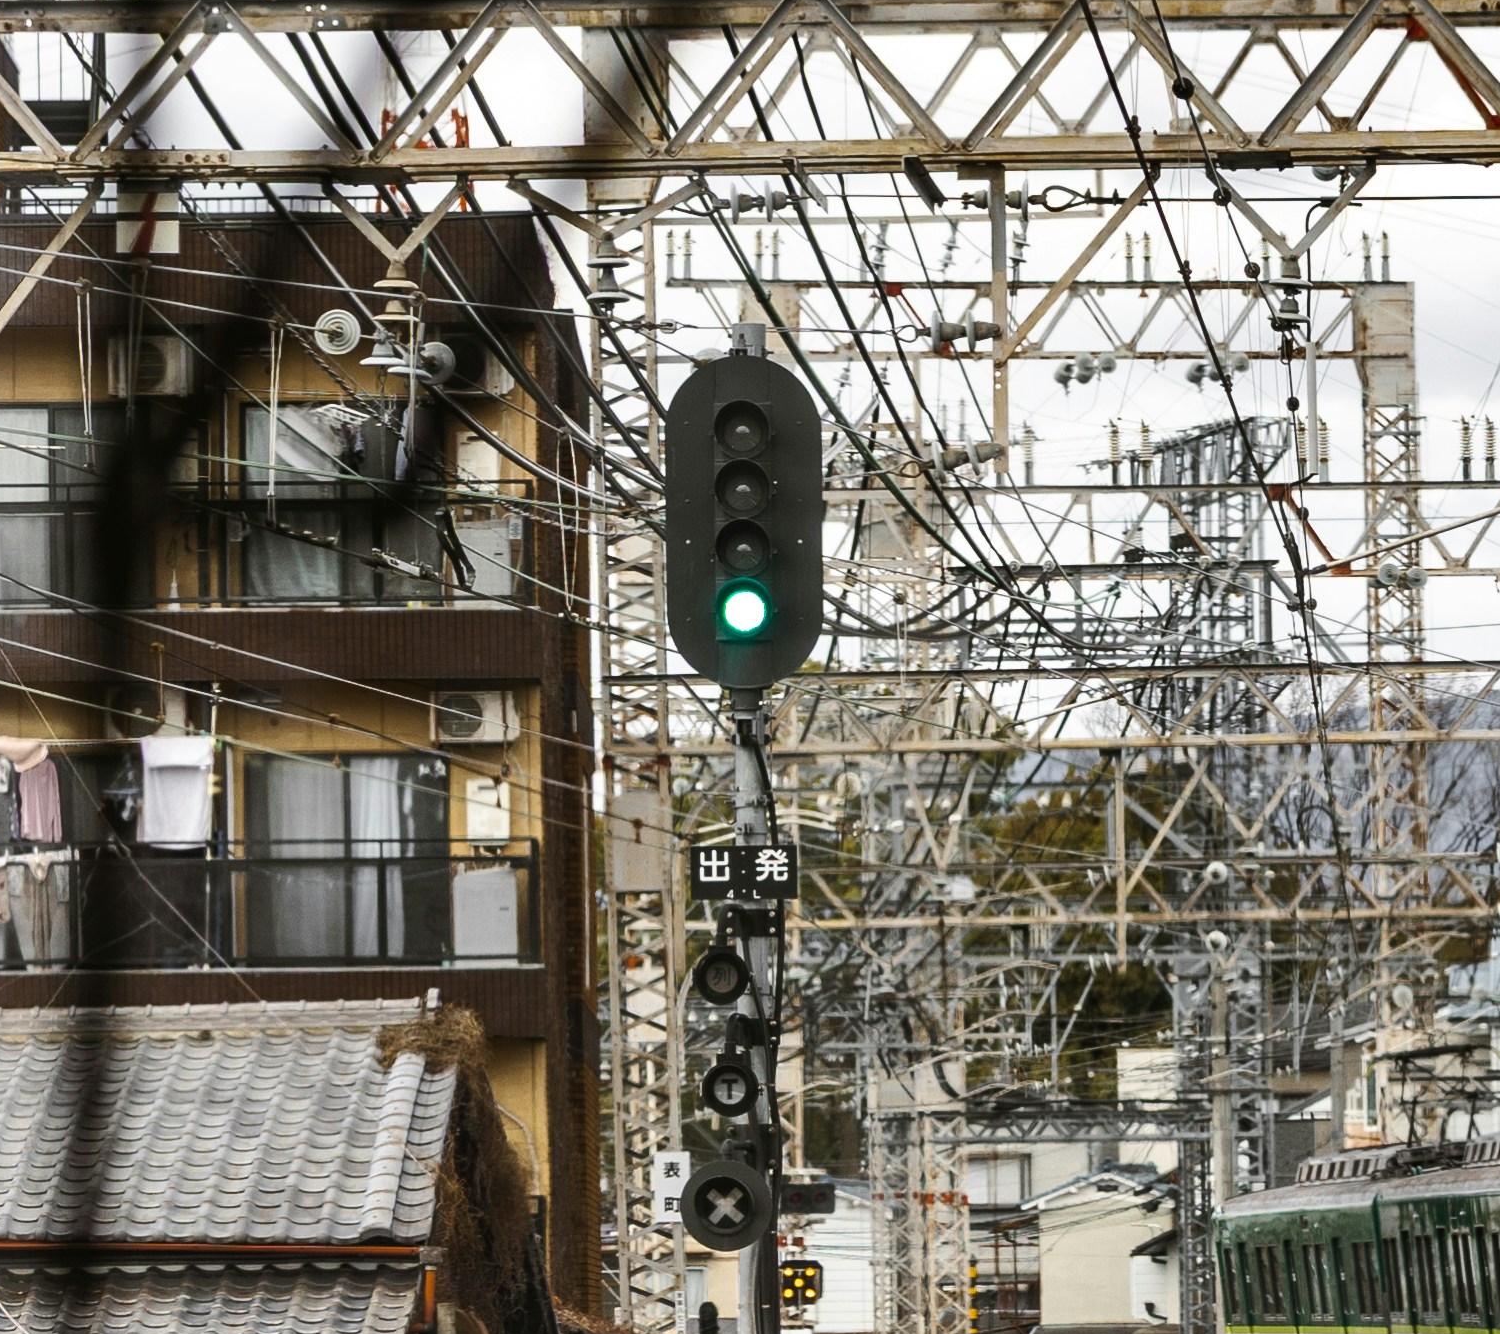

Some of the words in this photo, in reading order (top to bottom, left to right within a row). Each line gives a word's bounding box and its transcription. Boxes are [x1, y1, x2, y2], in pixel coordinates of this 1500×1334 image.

[699, 848, 789, 882] 出発
[752, 888, 762, 900] L
[721, 1078, 739, 1101] T
